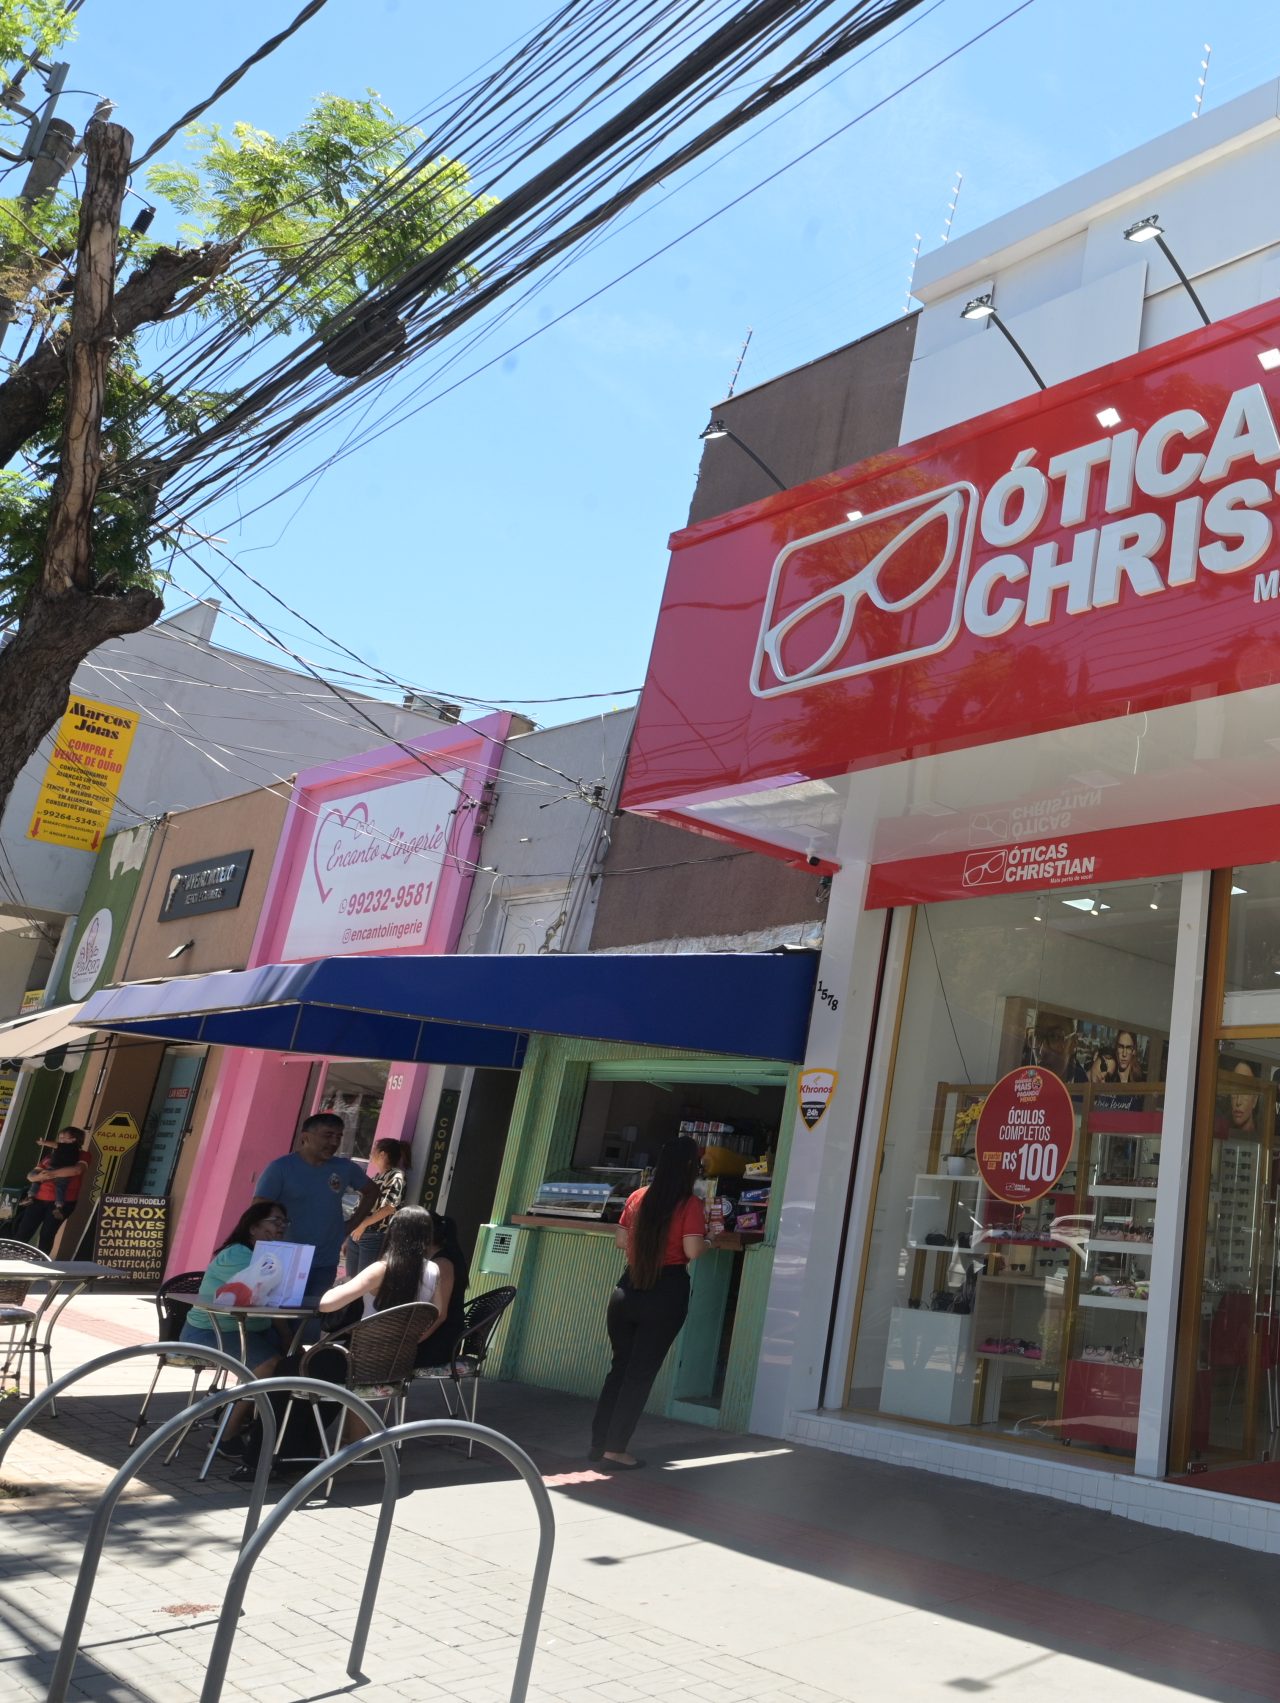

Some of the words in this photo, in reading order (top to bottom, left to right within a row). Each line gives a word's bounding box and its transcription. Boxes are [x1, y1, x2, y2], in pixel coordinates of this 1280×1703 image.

[69, 702, 134, 730] Marcos
[67, 738, 106, 757] COMPRA
[108, 749, 114, 759] E
[54, 748, 83, 764] VENDE
[84, 755, 96, 768] DE
[97, 758, 122, 774] OURO
[43, 809, 97, 827] 99264-5345
[327, 837, 380, 872] Encanto
[381, 824, 444, 864] Lingerie
[1008, 842, 1068, 865] ÓTICAS
[1005, 856, 1095, 882] CHRISTIAN
[347, 881, 433, 916] 99232-9581
[351, 919, 423, 942] encantolingerie
[817, 981, 839, 1011] 1578
[799, 1085, 833, 1094] Khronos
[1014, 1082, 1032, 1092] MAIS
[806, 1109, 819, 1117] 24h
[1008, 1106, 1045, 1125] ÓCULOS
[97, 1131, 116, 1139] FAÇA
[118, 1132, 138, 1140] AQUI
[999, 1125, 1051, 1141] COMPLETOS
[428, 1118, 448, 1186] COMPRO
[1002, 1151, 1018, 1172] R$
[1019, 1143, 1058, 1182] 100
[105, 1196, 138, 1205] CHAVEIRO
[138, 1198, 166, 1206] MODELO
[102, 1206, 167, 1219] XEROX
[100, 1219, 166, 1230] CHAVES
[100, 1229, 122, 1238] LAN
[126, 1230, 164, 1239] HOUSE
[98, 1239, 164, 1248] CARIMBOS
[98, 1248, 162, 1260] ENCADERNAÇÃO
[96, 1258, 162, 1270] PLASTIFICAÇÃO
[132, 1271, 160, 1280] BOLETO
